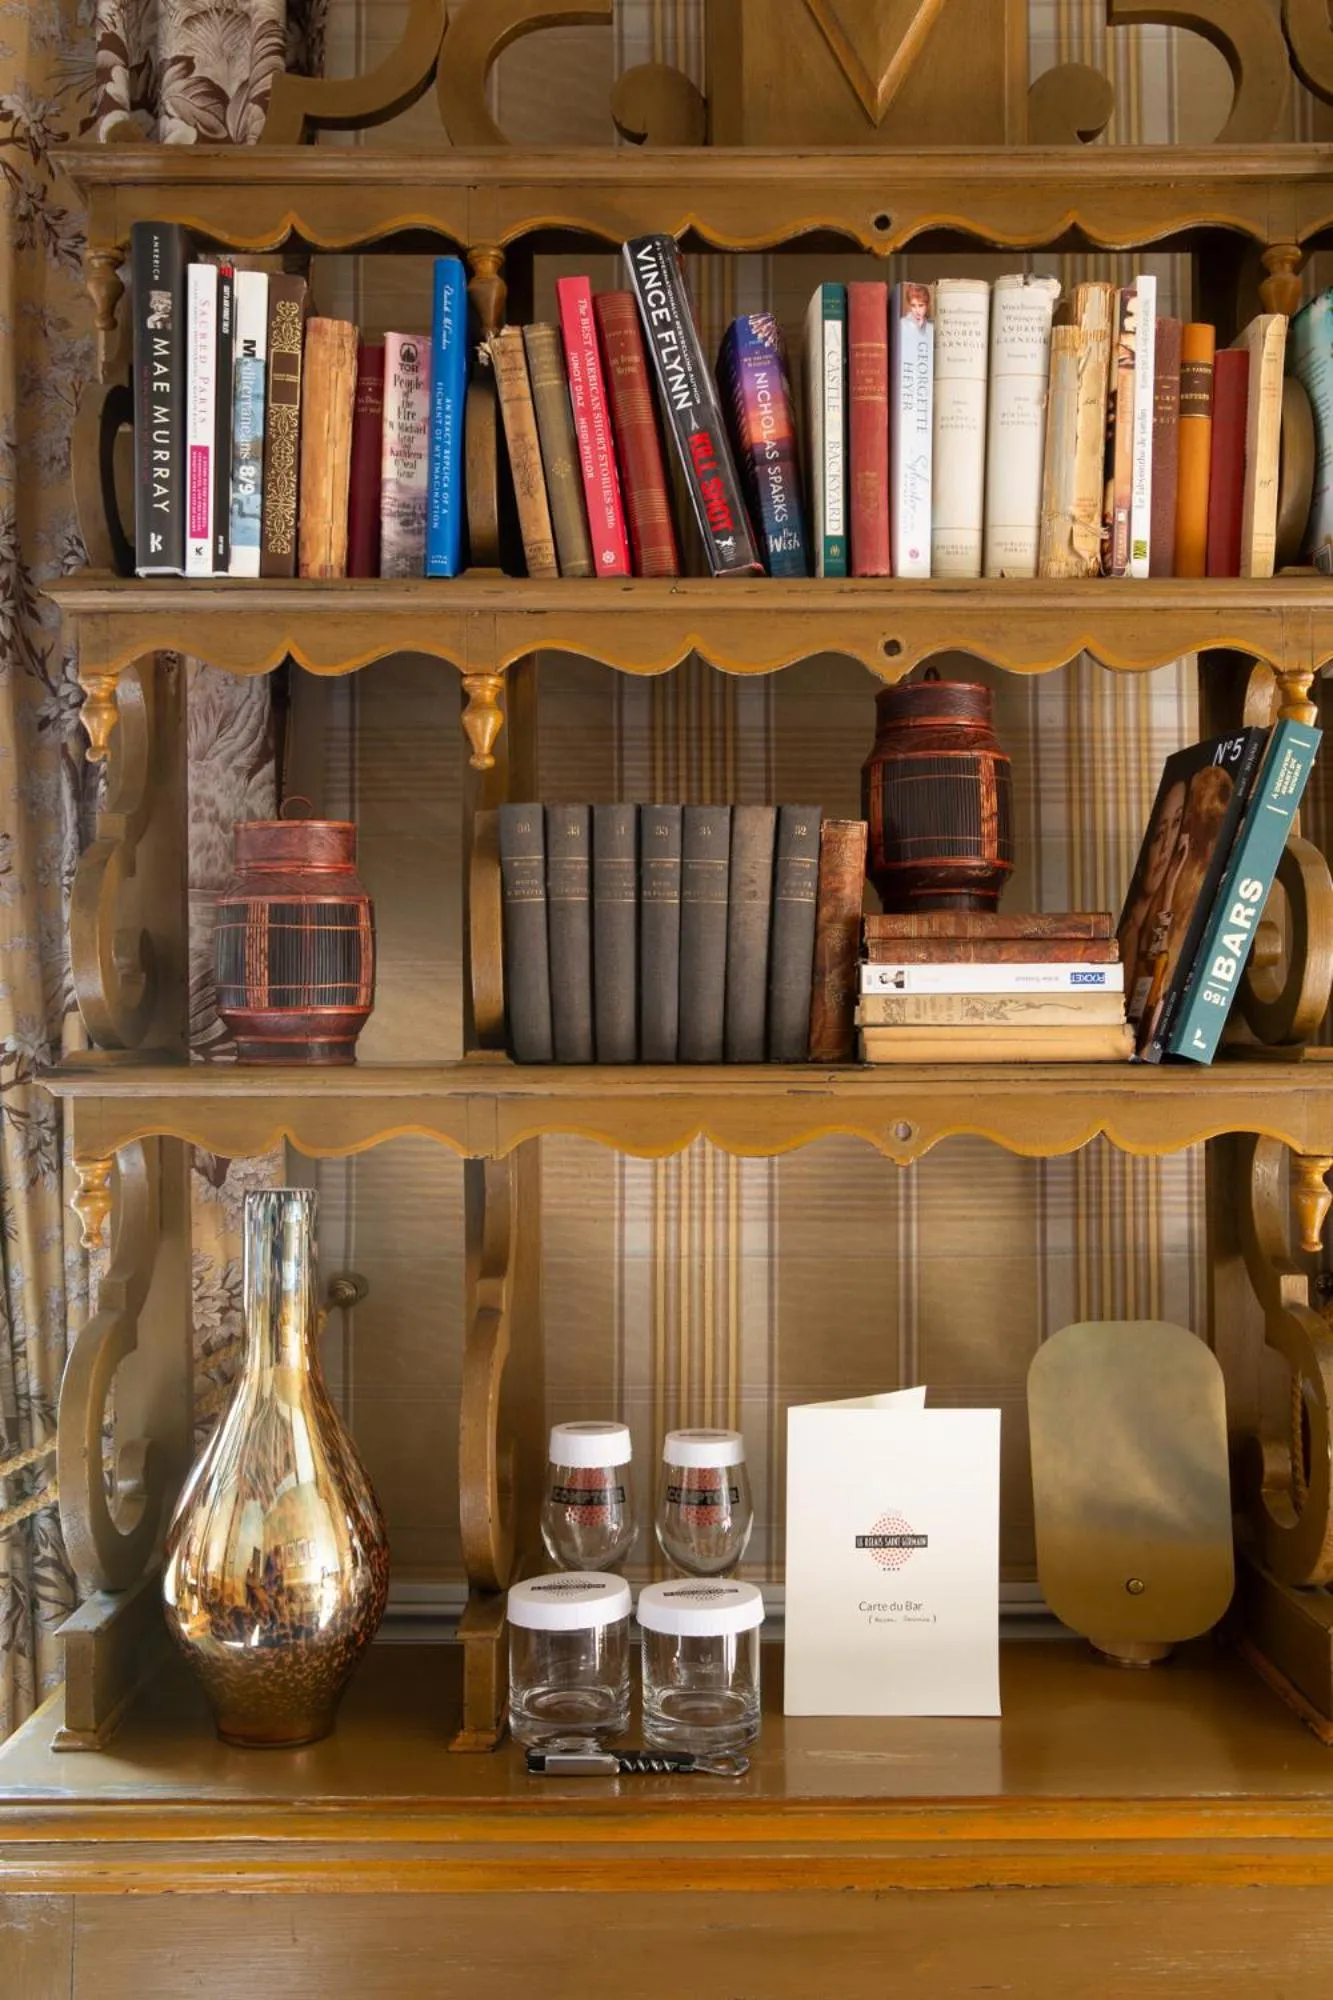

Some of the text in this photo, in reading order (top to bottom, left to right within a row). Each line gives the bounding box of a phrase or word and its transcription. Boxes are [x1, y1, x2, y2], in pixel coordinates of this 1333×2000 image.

[580, 317, 593, 347] BEST
[636, 244, 693, 412] VINCE FLYNN
[656, 252, 679, 320] INTERNATIONALLY
[687, 373, 701, 405] AUTHOR
[198, 376, 210, 425] PARIS
[583, 350, 602, 412] AMERICAN
[826, 349, 841, 413] CASTLE
[902, 362, 914, 412] HEYER
[916, 341, 929, 435] GEORGETTE
[152, 338, 170, 513] MAE MURRAY
[443, 414, 451, 445] EXACT
[592, 412, 607, 452] SHORT
[753, 372, 779, 460] NICHOLAS
[766, 466, 788, 523] SPARKS
[442, 449, 451, 488] REPLICA
[686, 431, 717, 477] KILL
[239, 465, 256, 495] 8/9
[597, 454, 614, 504] STORIES
[827, 440, 841, 532] BACKYARD
[699, 480, 735, 535] SHOT
[769, 533, 801, 553] Wish
[1211, 877, 1264, 983] BARS
[1070, 972, 1105, 984] POCKET
[1203, 990, 1227, 1007] 150
[884, 1536, 900, 1547] SAINT
[858, 1601, 923, 1612] Carte du Bar
